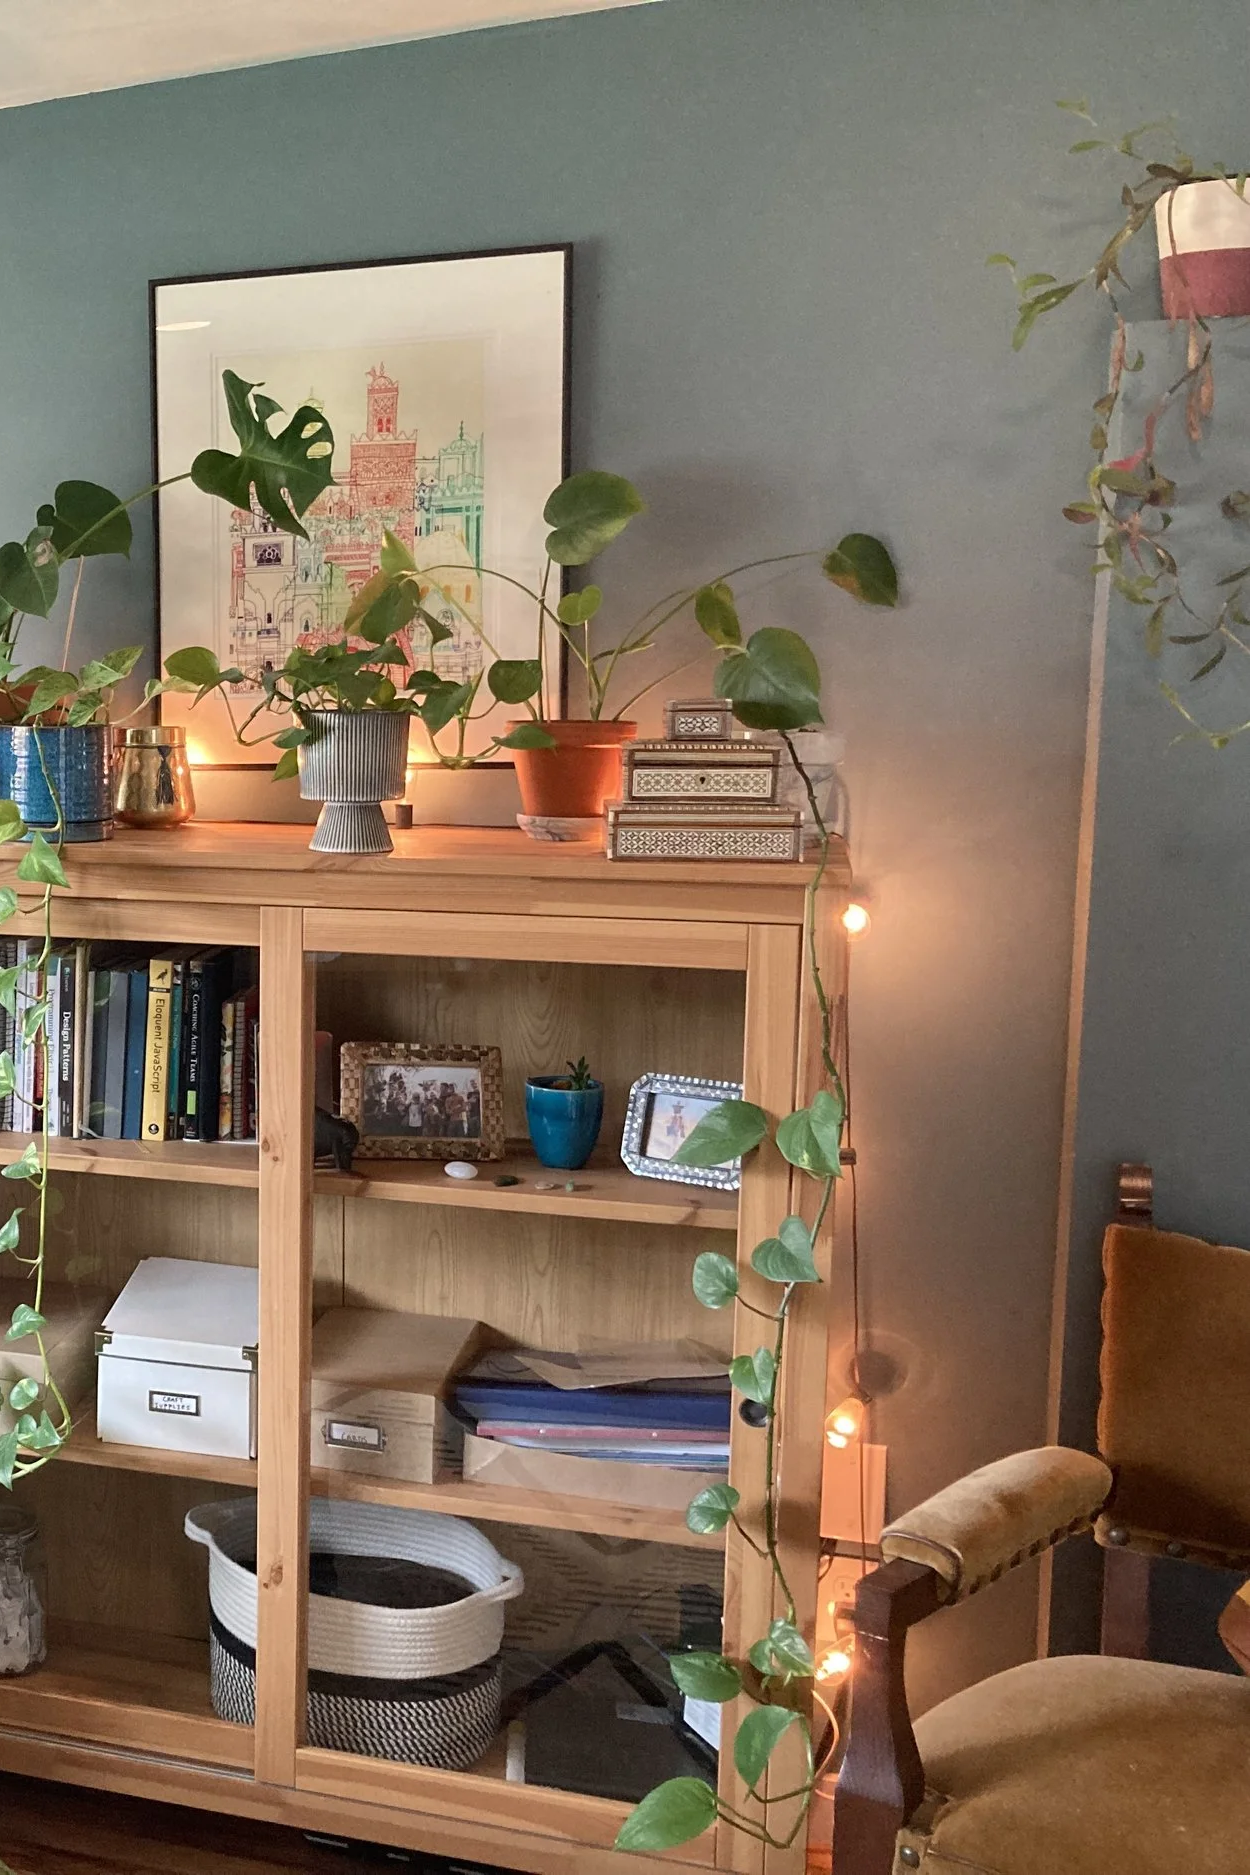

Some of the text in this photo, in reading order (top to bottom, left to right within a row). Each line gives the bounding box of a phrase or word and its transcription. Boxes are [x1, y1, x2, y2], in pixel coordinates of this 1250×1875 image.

[152, 998, 166, 1040] Eloquent
[61, 1011, 71, 1082] Design Patterns
[149, 1042, 163, 1094] JavaScript
